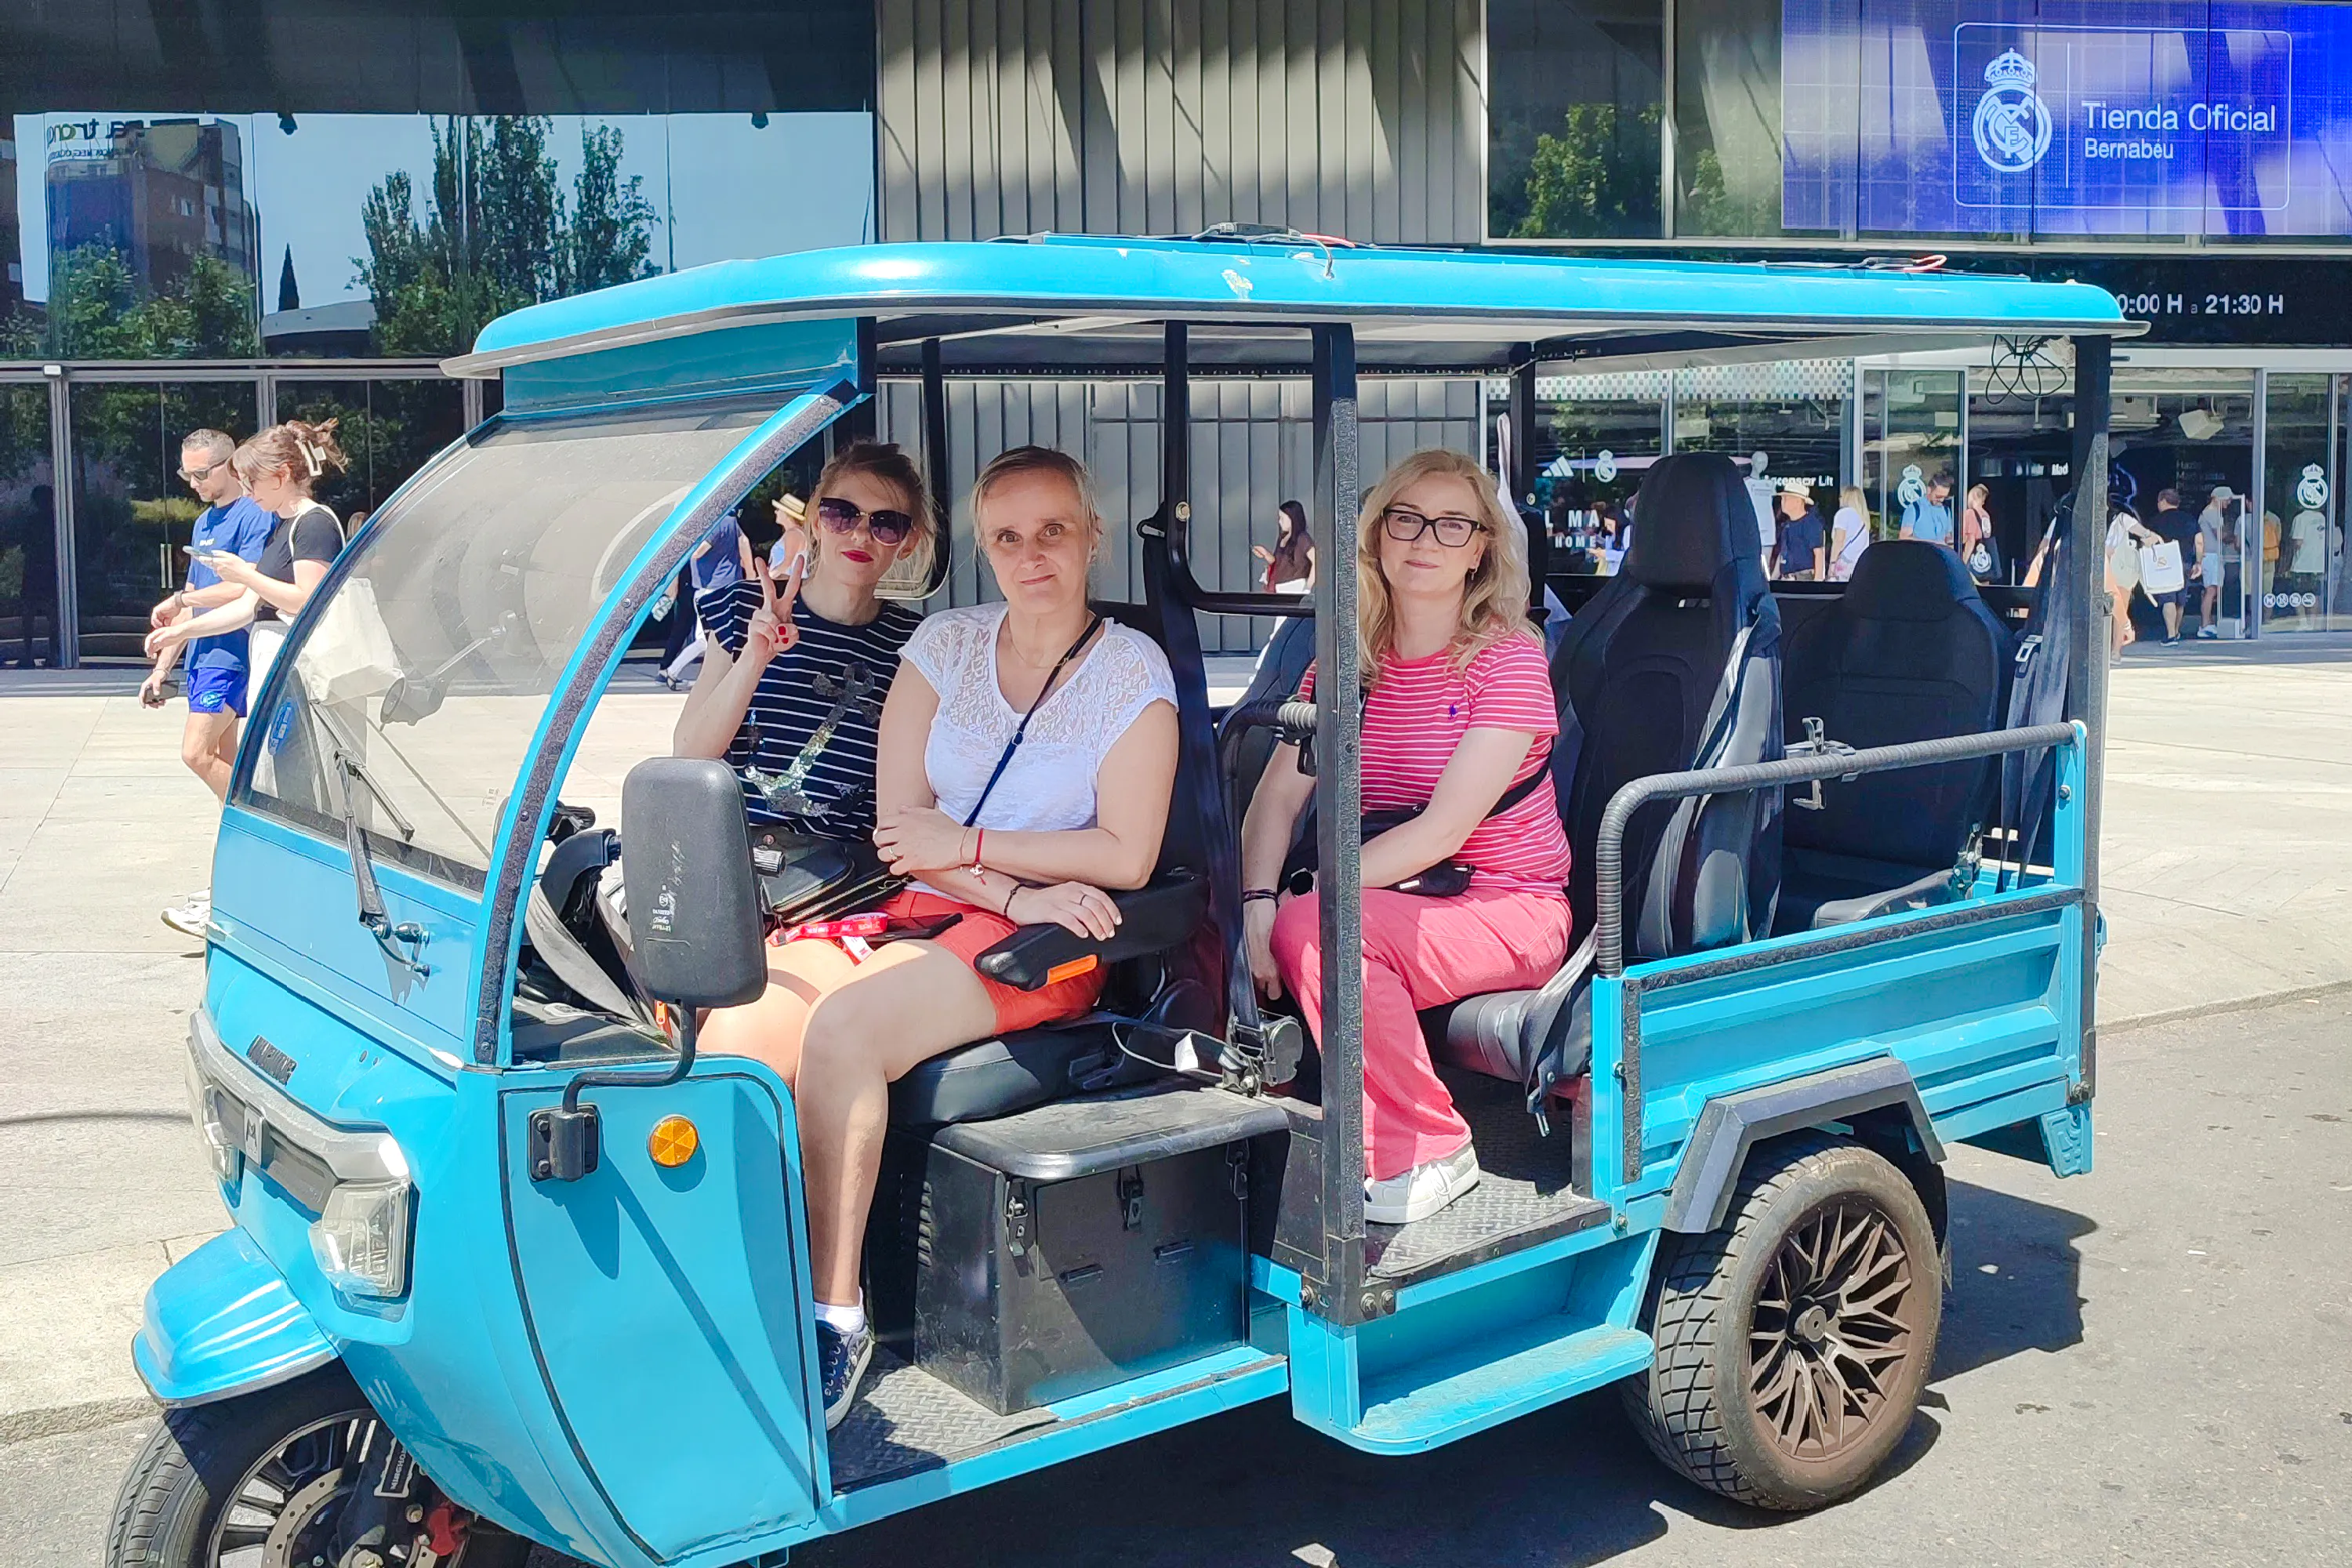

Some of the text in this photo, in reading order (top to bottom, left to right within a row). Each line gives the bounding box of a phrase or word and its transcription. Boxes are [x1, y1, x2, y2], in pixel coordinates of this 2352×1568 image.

[2082, 100, 2276, 132] Tienda Oficial
[2085, 137, 2174, 159] Bernabéu
[2116, 293, 2160, 314] 0:00
[2166, 293, 2183, 314] H
[2205, 294, 2262, 314] 21:30
[2268, 294, 2285, 314] H
[1555, 535, 1597, 548] HOME
